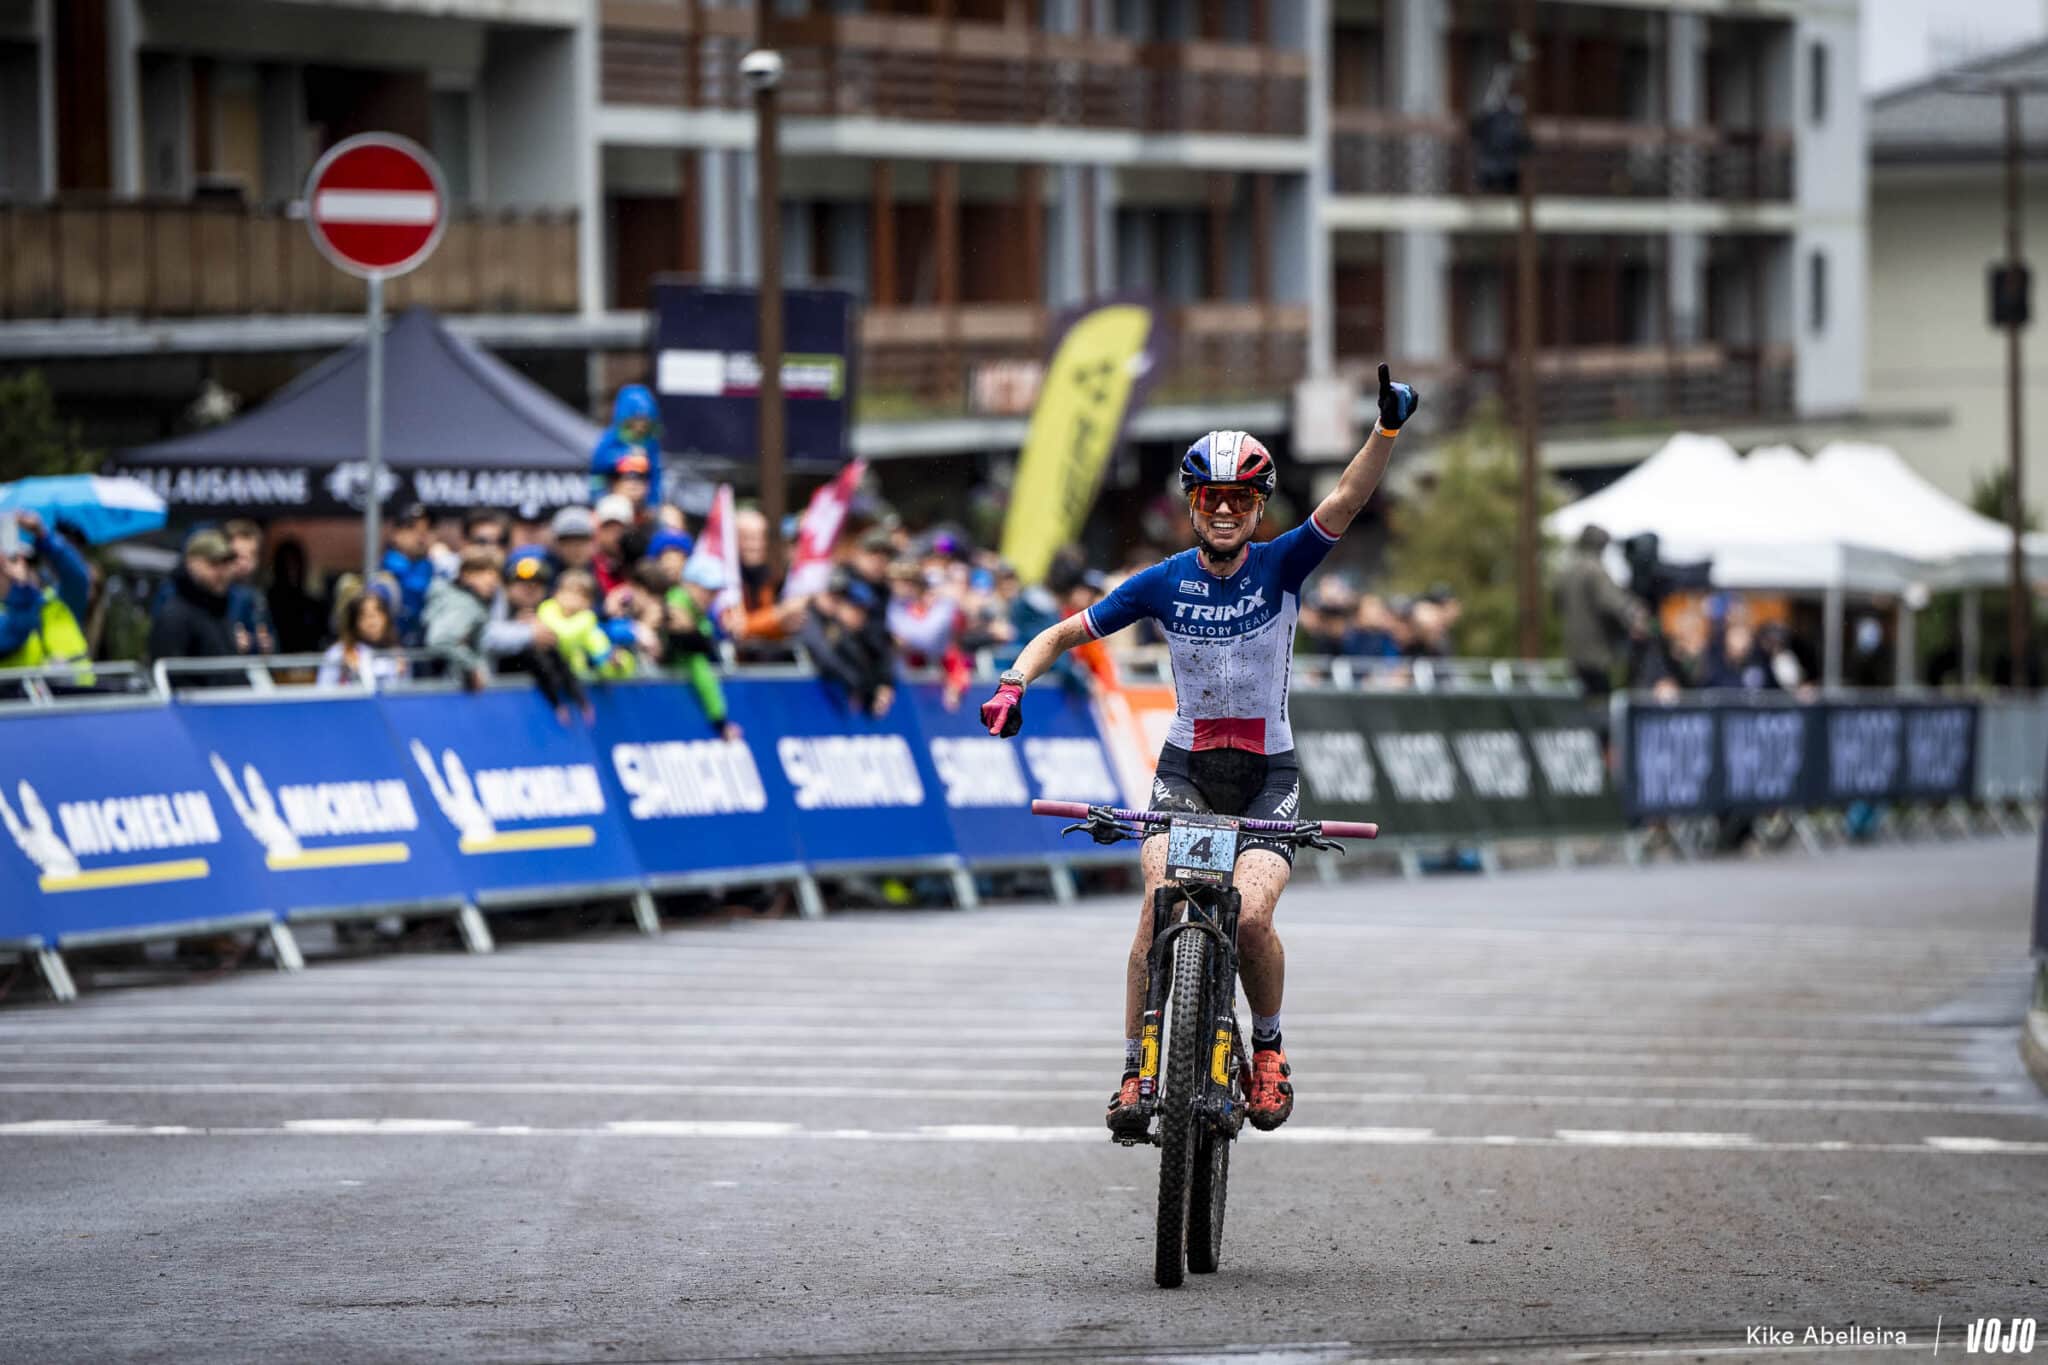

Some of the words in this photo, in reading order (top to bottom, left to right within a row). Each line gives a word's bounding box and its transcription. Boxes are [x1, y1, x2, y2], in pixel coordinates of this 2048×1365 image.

[413, 467, 592, 505] VALAISANN
[1173, 586, 1267, 621] TRINX
[1172, 621, 1232, 636] FACTORY
[1239, 609, 1271, 632] TEAM
[278, 779, 418, 838] MICHELIN
[474, 764, 605, 821] MICHELIN
[58, 790, 221, 856] MICHELIN
[1113, 808, 1163, 822] SWITCH
[1245, 818, 1295, 832] SWITCH
[1189, 836, 1213, 862] 4
